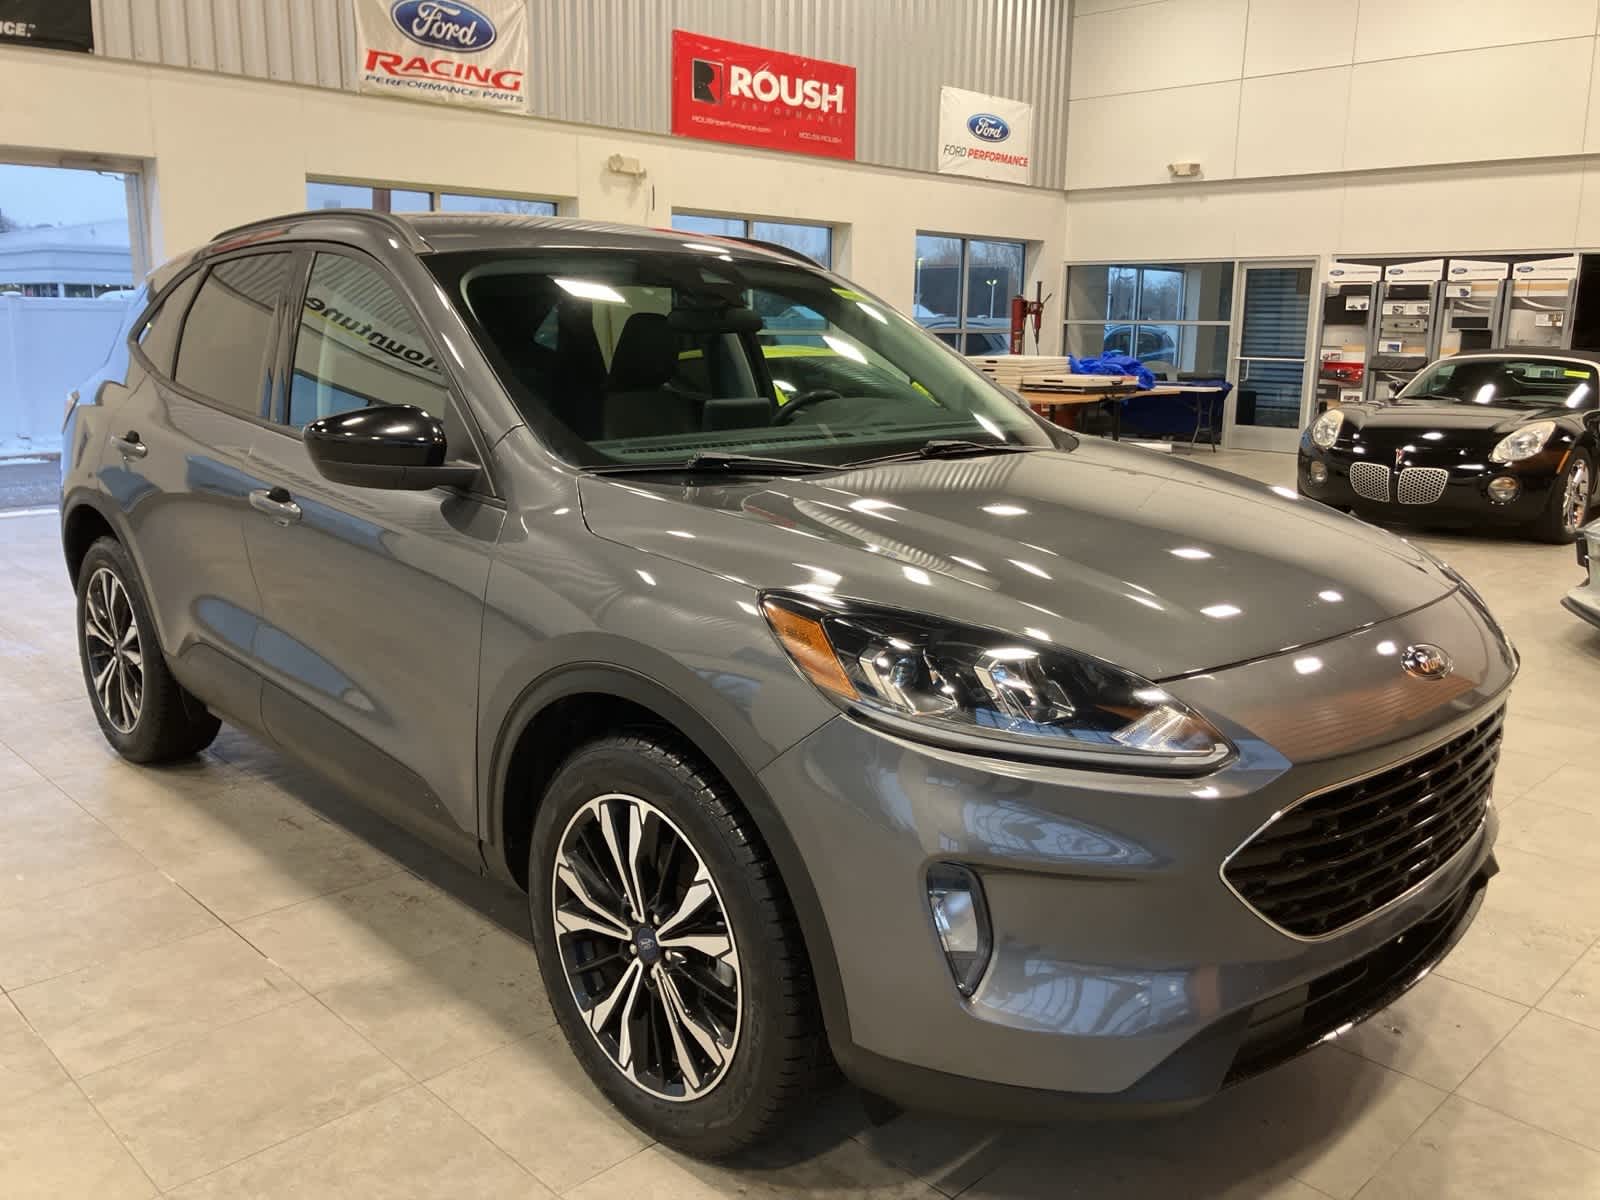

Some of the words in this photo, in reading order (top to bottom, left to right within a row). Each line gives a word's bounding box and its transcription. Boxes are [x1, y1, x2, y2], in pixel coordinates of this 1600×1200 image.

[412, 2, 477, 46] Ford
[366, 50, 523, 91] RACING
[366, 74, 479, 97] PERFORMANCE
[482, 91, 524, 103] PARTS
[730, 65, 844, 113] ROUSH
[975, 117, 1002, 138] Ford
[943, 144, 967, 157] FORD
[968, 148, 1028, 167] PERFORMANCE
